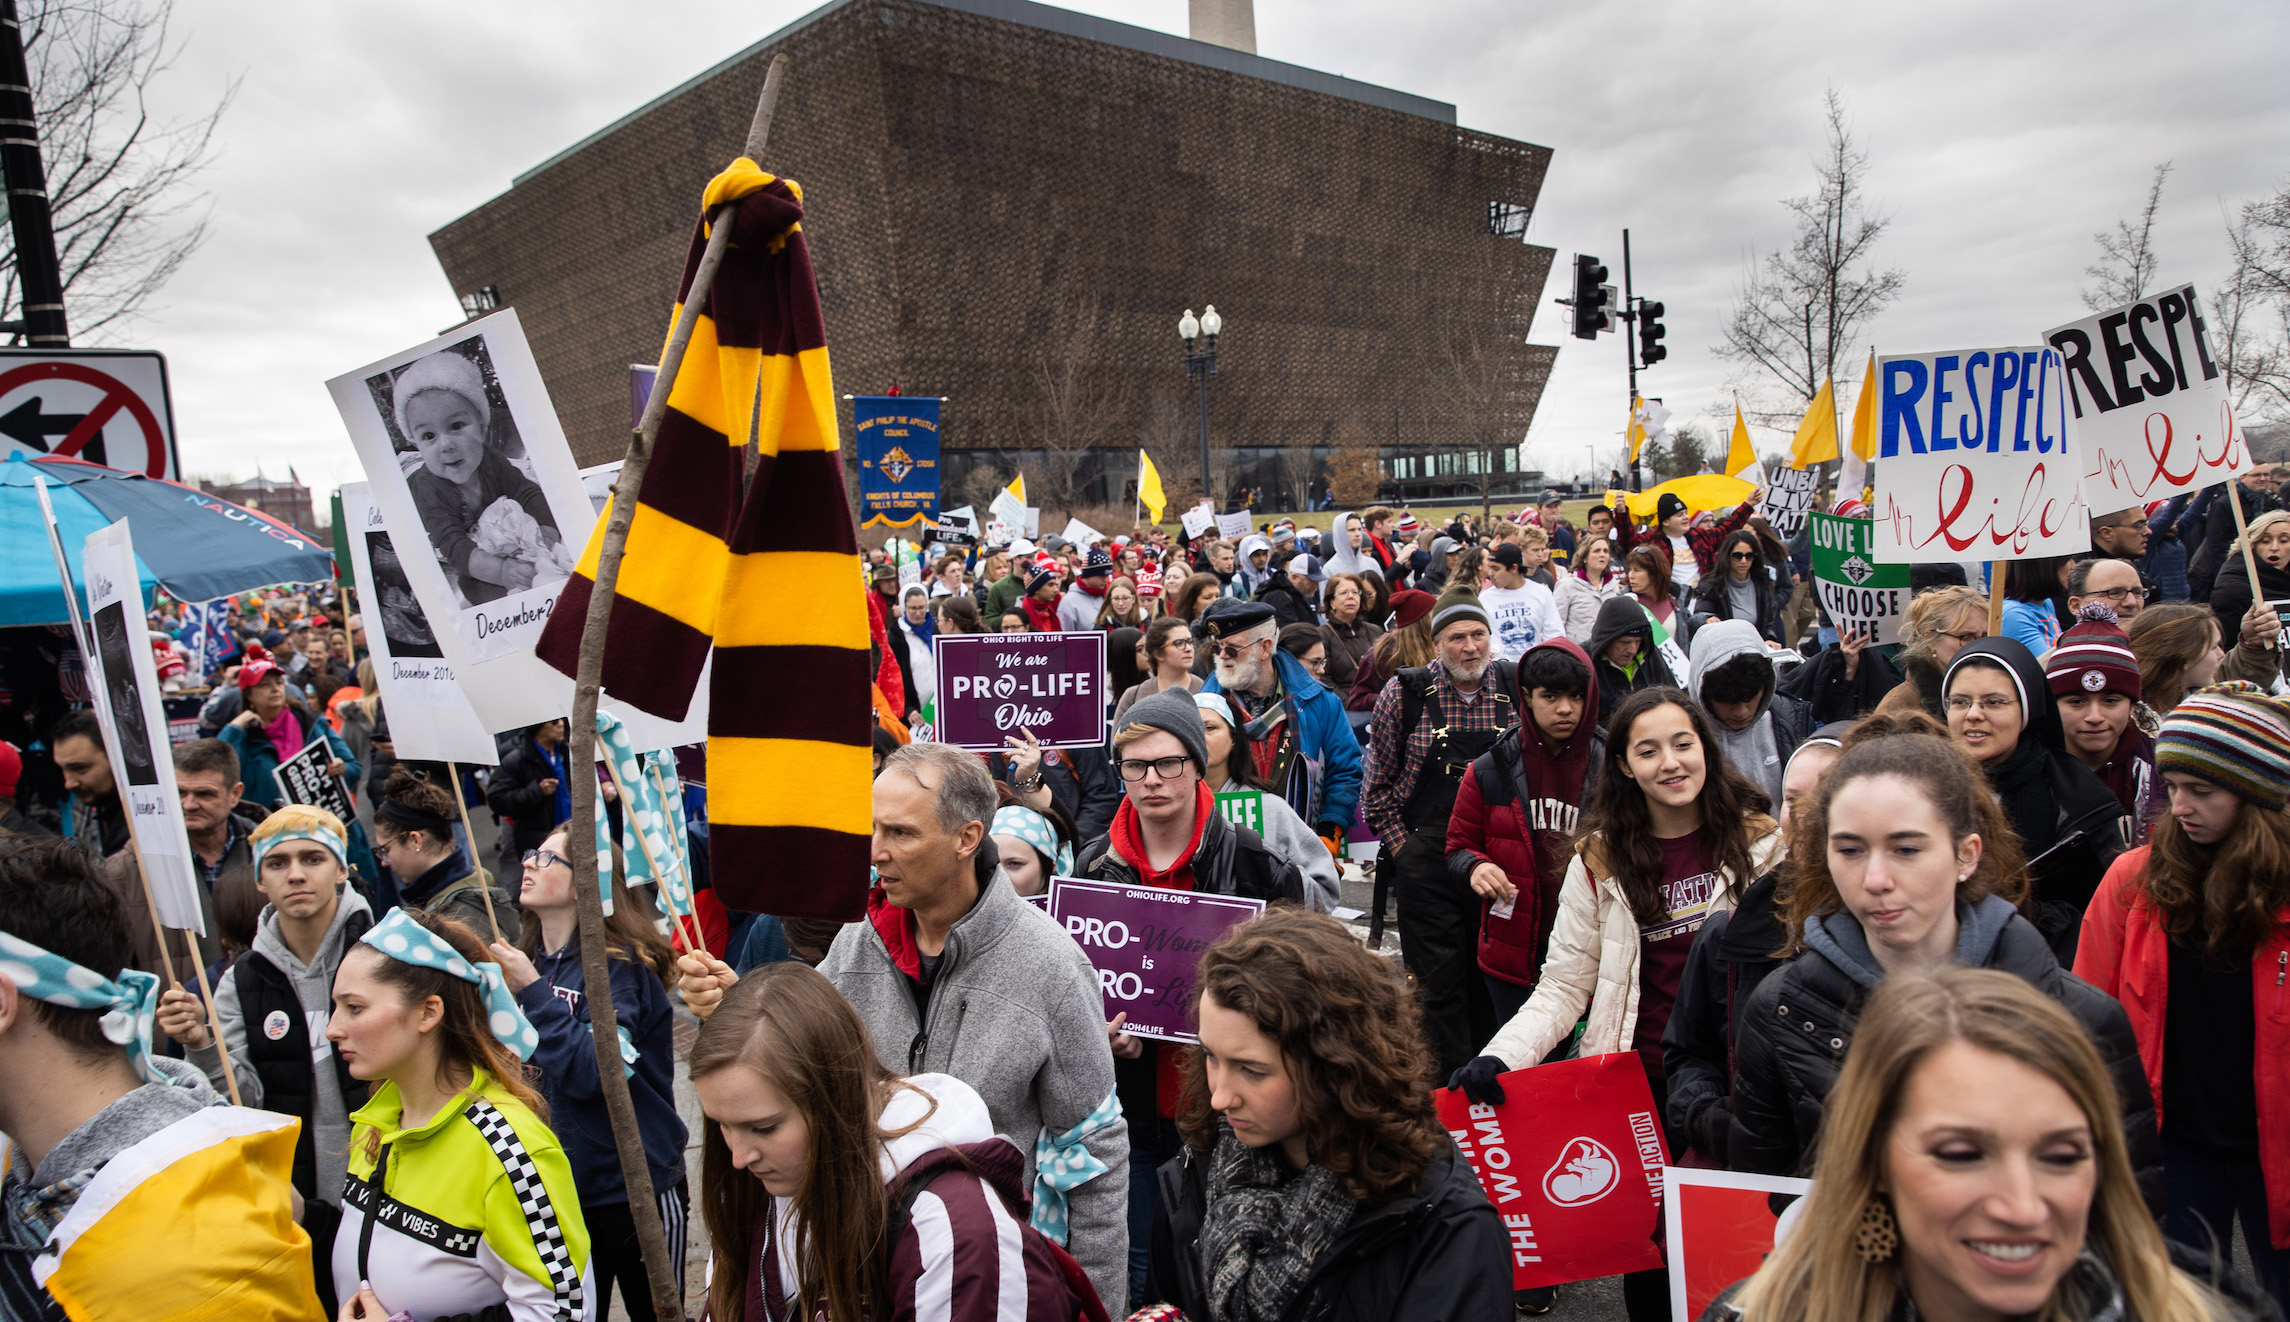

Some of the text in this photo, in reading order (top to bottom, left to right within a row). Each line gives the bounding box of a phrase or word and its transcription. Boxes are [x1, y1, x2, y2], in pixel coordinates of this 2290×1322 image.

[1881, 348, 2067, 459] RESPECT
[857, 416, 938, 433] SAINT PHILIP THE APOSTLE
[884, 429, 910, 437] COUNCIL
[866, 492, 891, 500] KNIGHTS
[902, 492, 936, 500] COLUMBUS
[871, 501, 891, 509] FALLS
[1916, 462, 2064, 555] life
[184, 494, 305, 551] NAUTICA
[936, 532, 960, 541] LIFE
[1812, 516, 1856, 553] LOVE
[1825, 582, 1899, 618] CHOOSE
[1494, 607, 1532, 619] LIFE
[982, 634, 1063, 644] OHIO RIGHT TO LIFE
[995, 651, 1049, 669] We are
[392, 661, 431, 681] December
[952, 672, 1091, 700] PRO-LIFE
[994, 702, 1054, 731] Ohio
[310, 750, 348, 818] I AM THE
[1221, 797, 1258, 831] IFE
[1126, 889, 1191, 905] OHIOLIFE.ORG
[1646, 929, 1673, 943] TRACK
[1141, 954, 1154, 971] is
[1122, 1021, 1164, 1036] #OH4LIFE
[1630, 1113, 1664, 1165] ACTION
[1468, 1100, 1543, 1268] THE WOMB
[401, 1211, 440, 1239] VIBES
